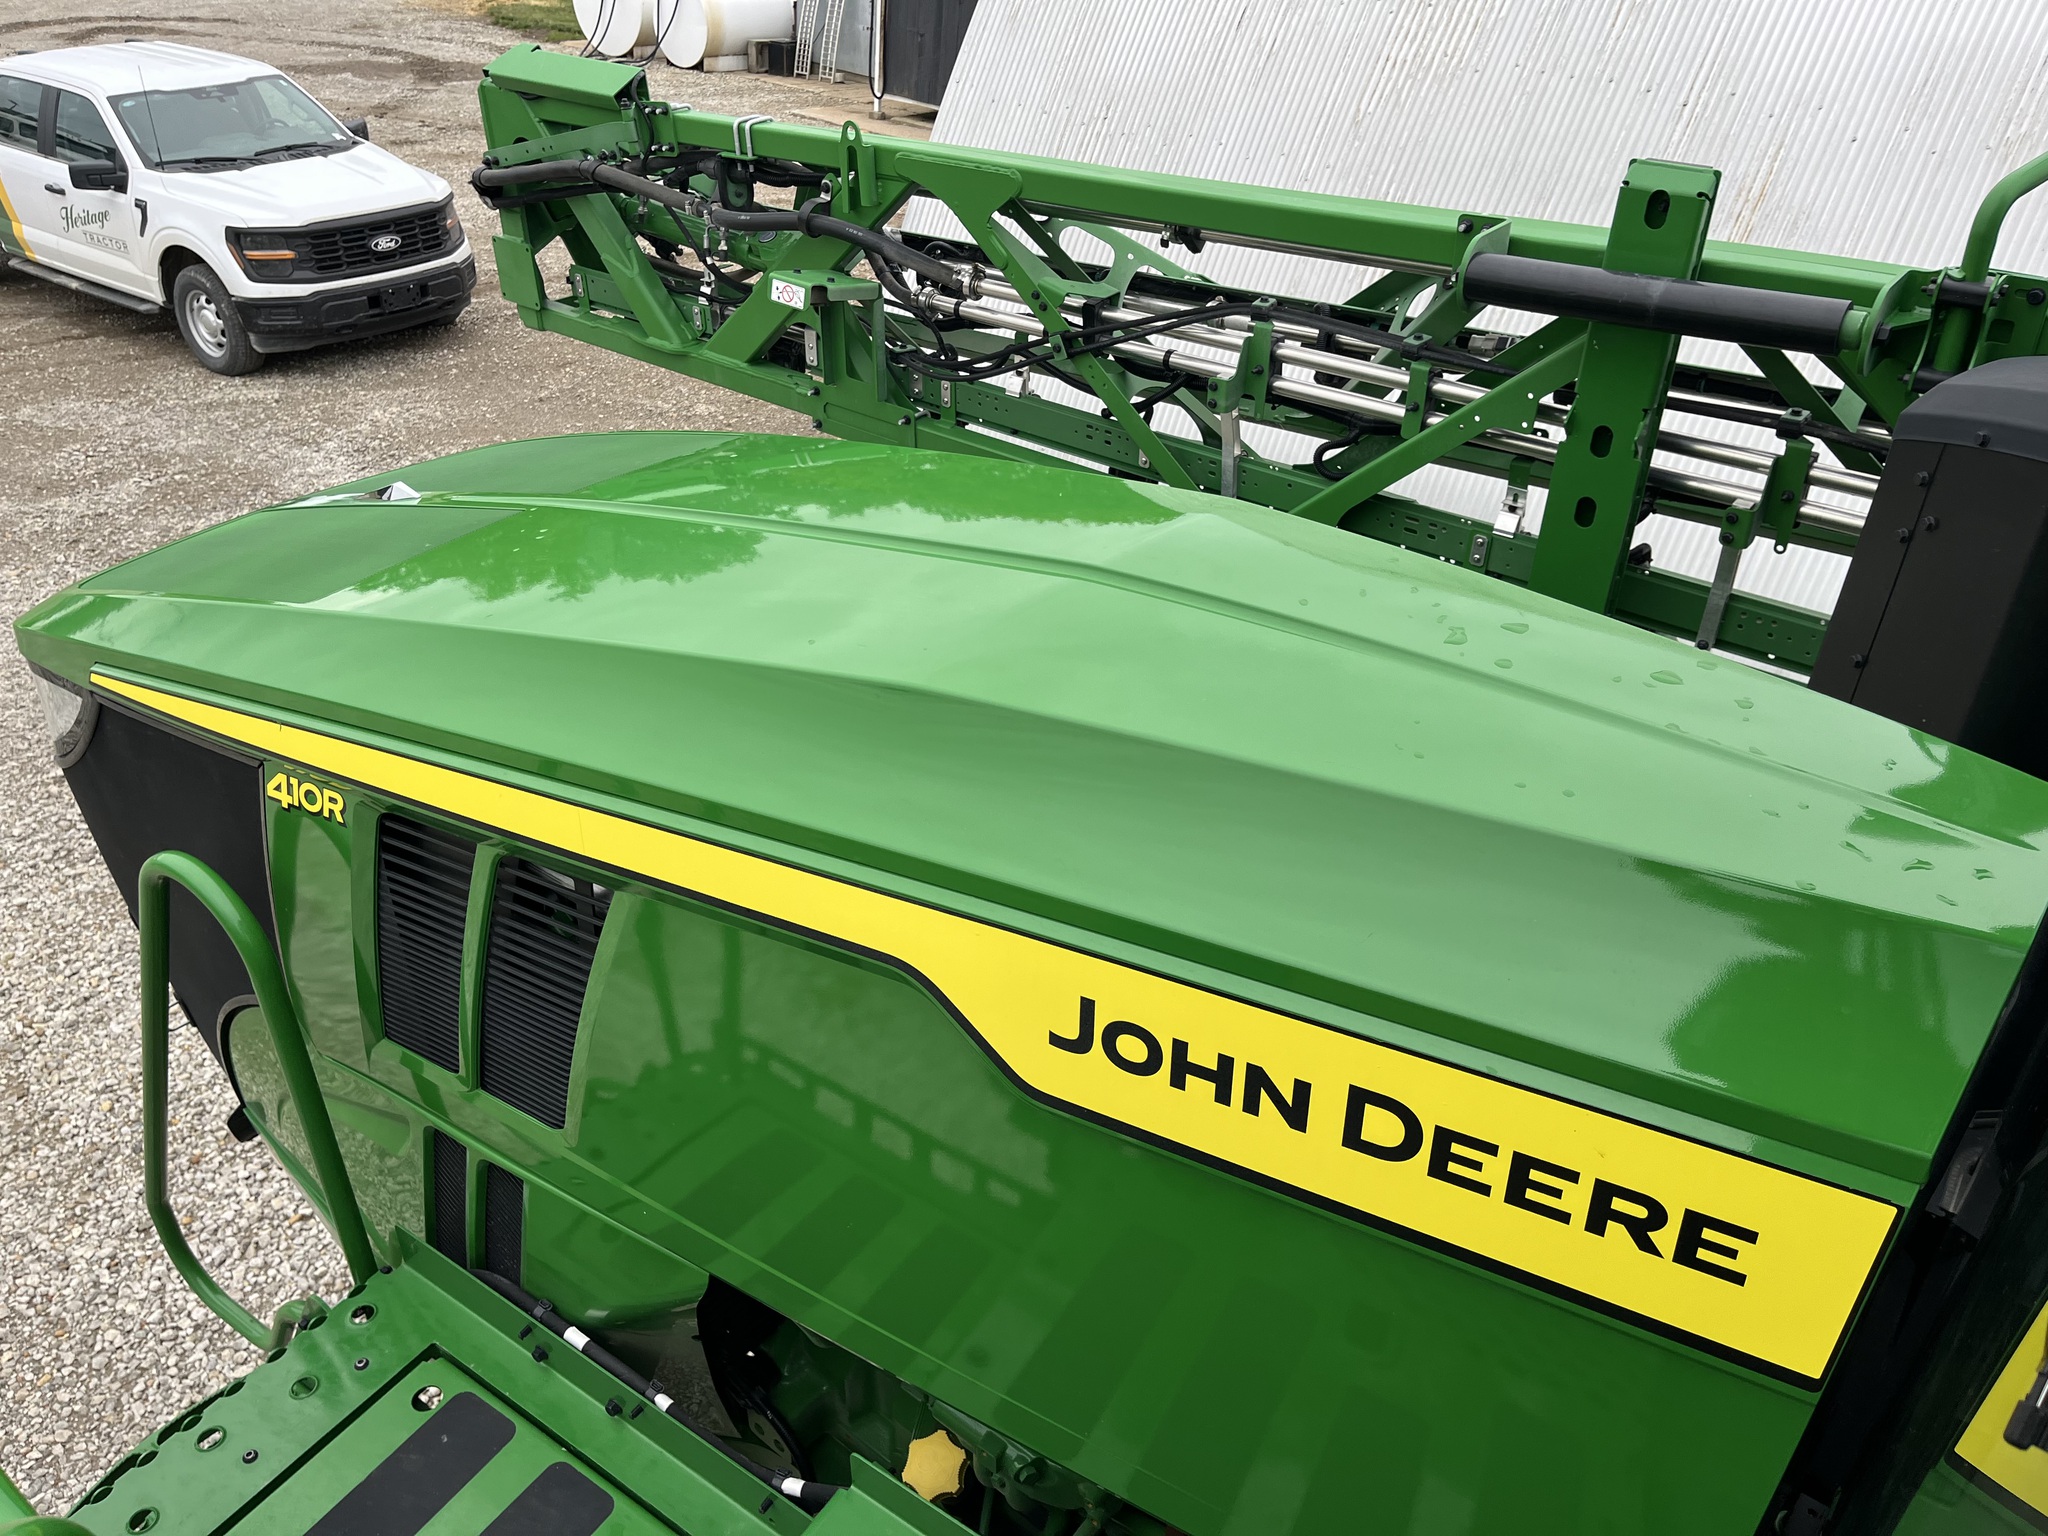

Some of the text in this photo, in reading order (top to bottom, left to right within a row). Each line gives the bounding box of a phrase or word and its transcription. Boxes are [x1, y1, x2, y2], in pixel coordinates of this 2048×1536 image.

[60, 204, 110, 233] Heritage
[83, 232, 130, 252] TRACTOR
[266, 772, 346, 826] 410R
[1048, 995, 1760, 1288] JOHN DEERE
